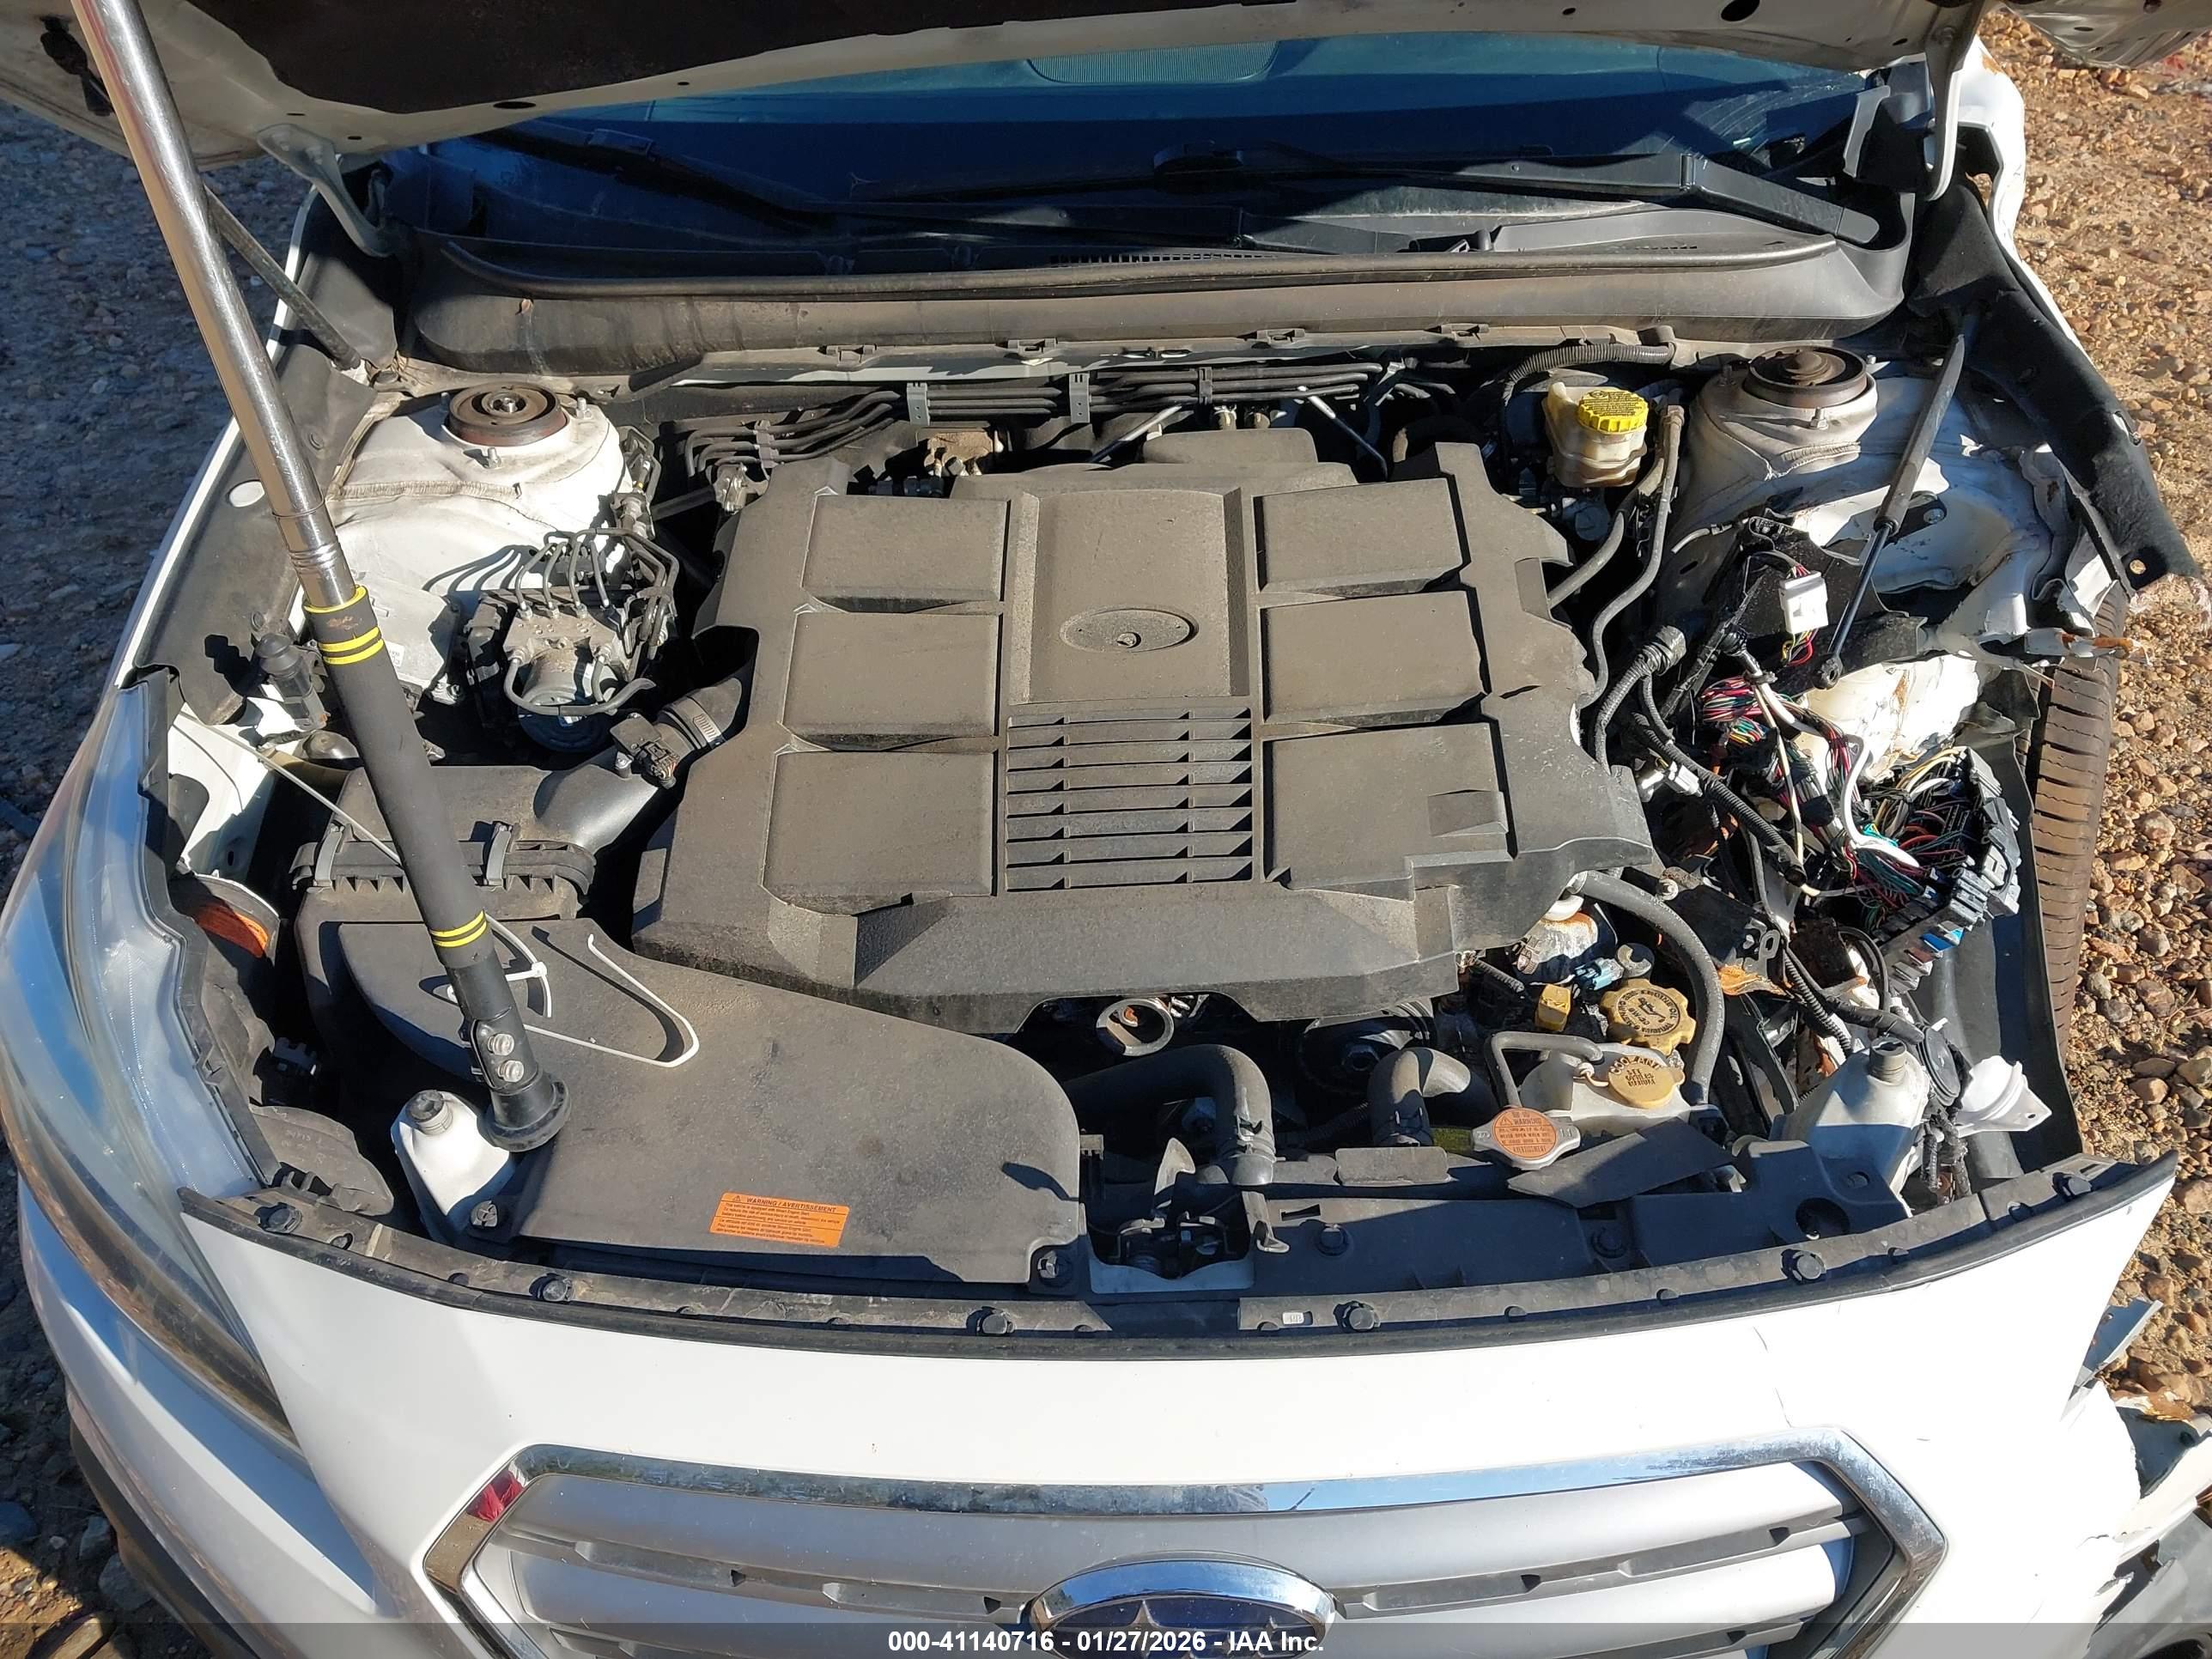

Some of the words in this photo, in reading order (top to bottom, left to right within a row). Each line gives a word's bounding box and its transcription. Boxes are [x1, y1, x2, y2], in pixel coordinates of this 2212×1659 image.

[1668, 1007, 1678, 1019] OIL
[1608, 1055, 1662, 1075] COOLANT
[746, 1197, 778, 1206] WARNING
[782, 1201, 837, 1212] AVERTISSEMENT
